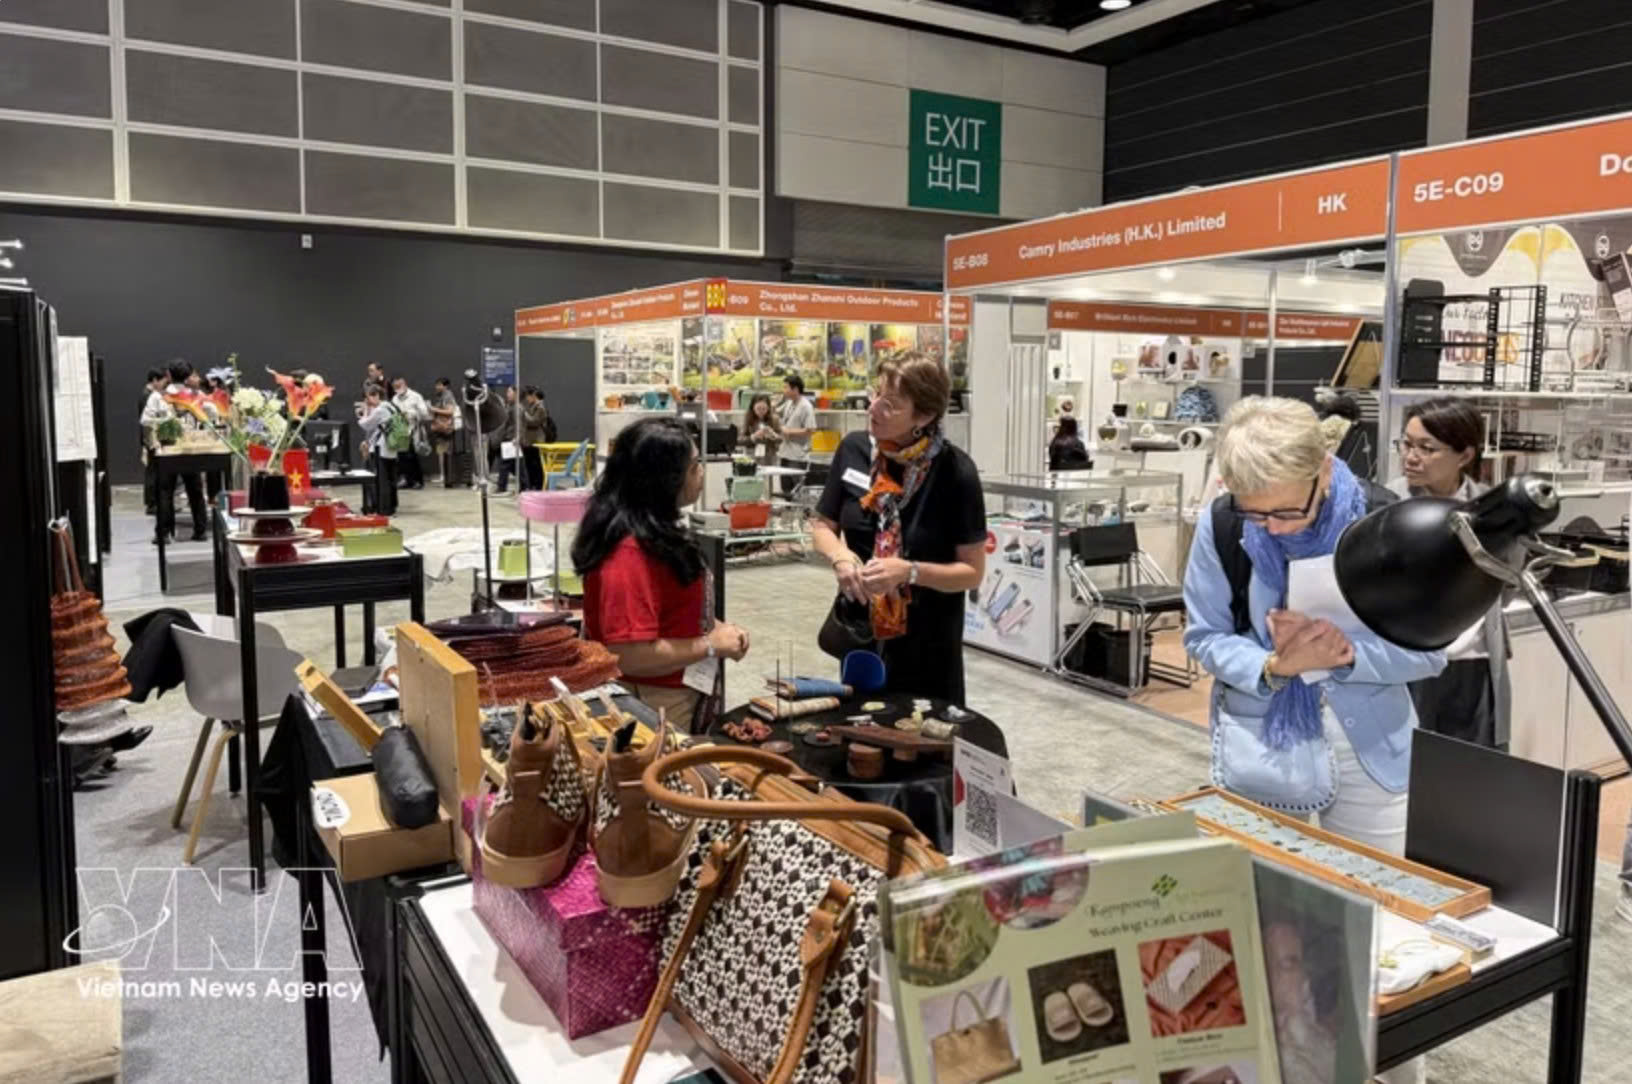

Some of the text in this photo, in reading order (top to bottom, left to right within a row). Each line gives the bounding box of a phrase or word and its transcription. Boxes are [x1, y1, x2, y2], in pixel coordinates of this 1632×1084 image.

[926, 112, 987, 151] EXIT
[928, 152, 981, 194] 出口
[1413, 172, 1505, 203] 5E-C09
[953, 192, 1347, 271] 5E-B08 Camry Industries (H.K.) Limited HK
[882, 295, 920, 308] Products
